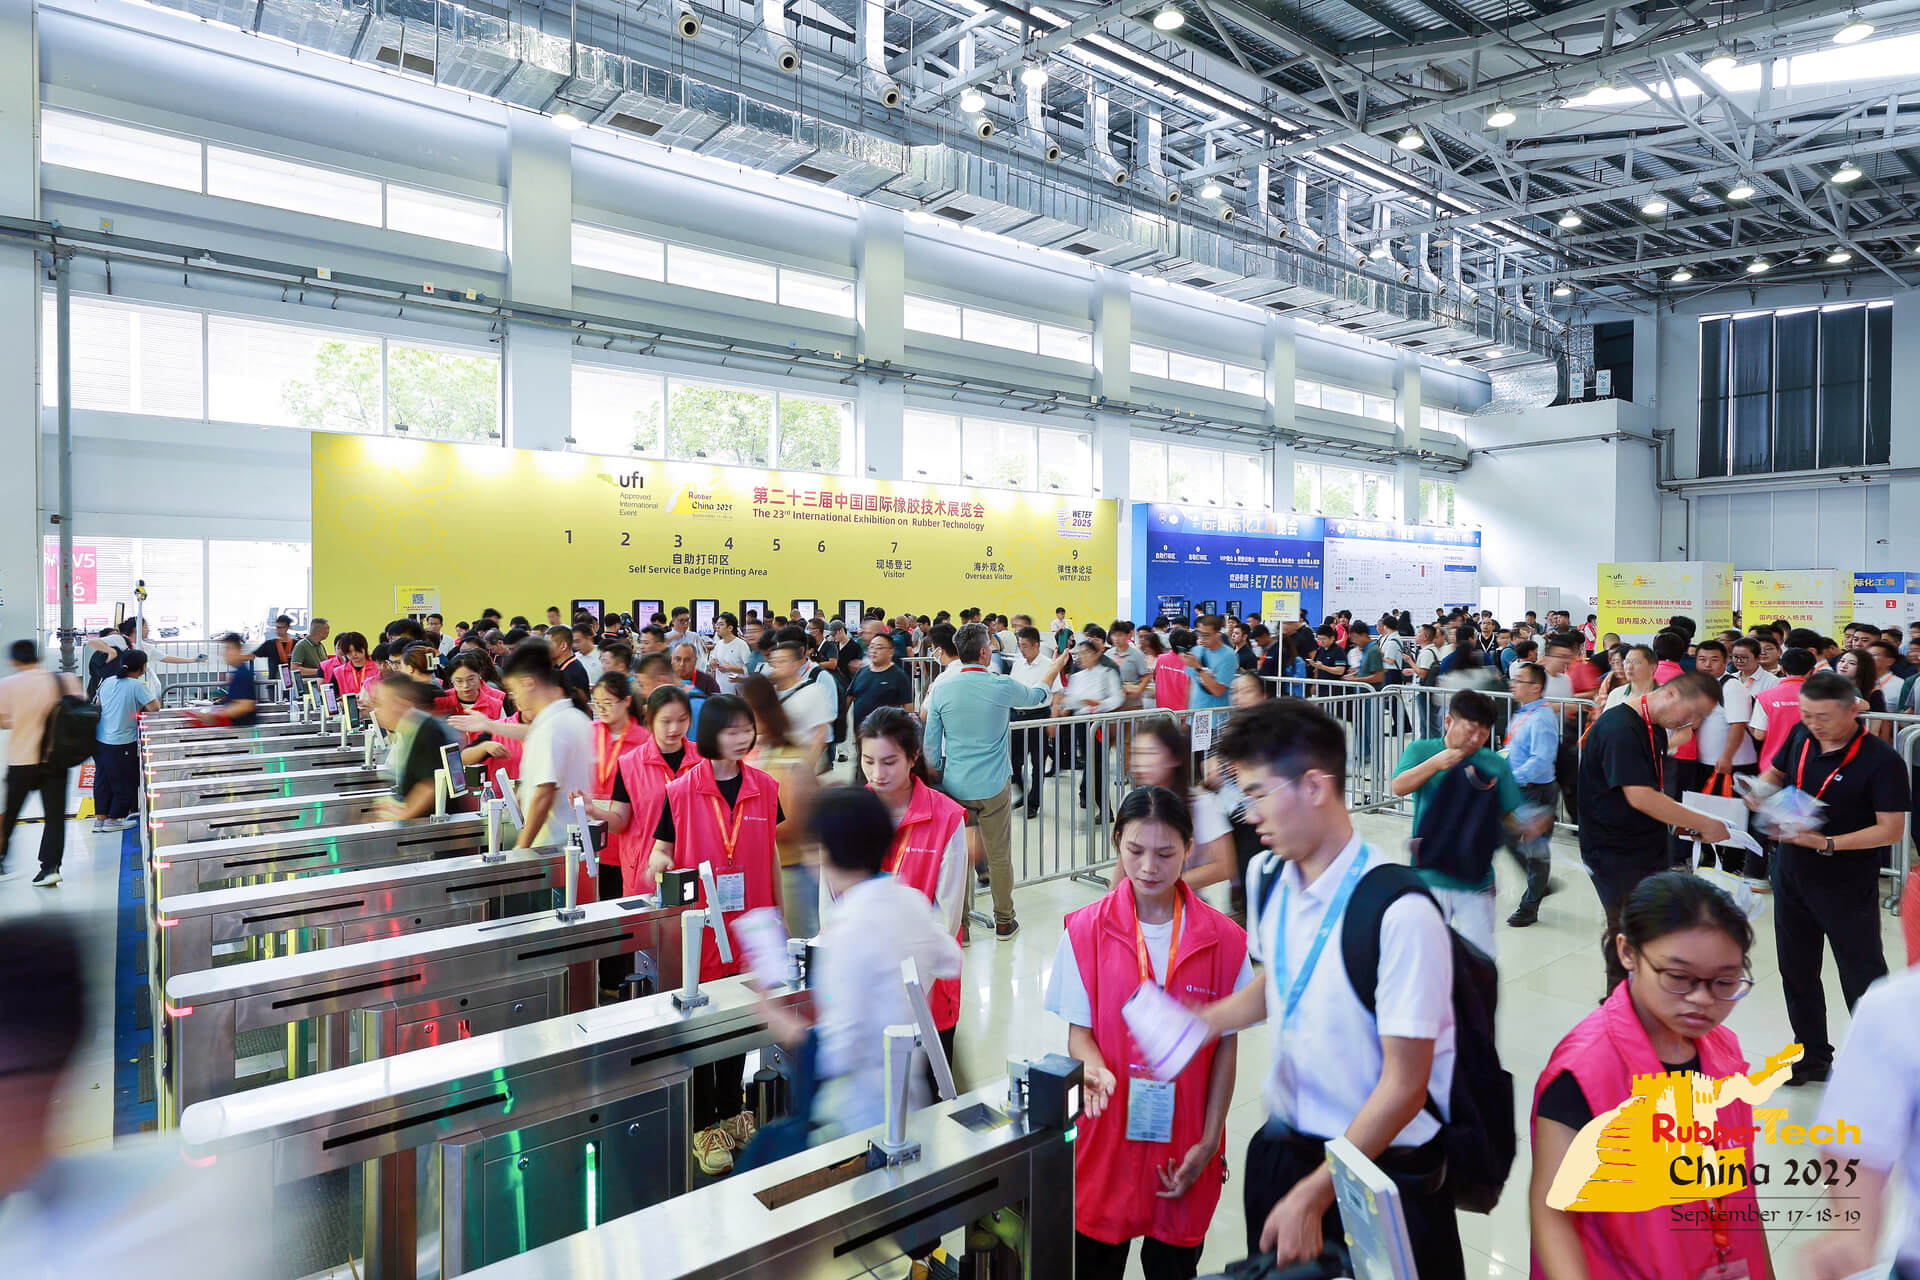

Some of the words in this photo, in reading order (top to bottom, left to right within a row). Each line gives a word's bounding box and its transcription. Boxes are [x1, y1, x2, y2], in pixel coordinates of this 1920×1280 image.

[619, 471, 644, 489] ufi
[620, 491, 651, 501] Approved
[619, 500, 659, 509] International
[691, 501, 715, 511] China
[716, 503, 733, 512] 2025
[752, 486, 986, 520] 第二十三届中国国际橡胶技术展览会
[619, 509, 638, 517] Event
[1072, 510, 1093, 519] WETEF
[753, 508, 771, 519] The
[773, 509, 791, 519] 23rd
[792, 510, 852, 523] International
[853, 514, 896, 526] Exhibition
[898, 518, 909, 526] on
[912, 517, 941, 529] Rubber
[942, 519, 985, 532] Technology
[1072, 518, 1092, 528] 2025
[564, 530, 573, 544] 1
[620, 532, 631, 546] 2
[674, 534, 683, 548] 3
[724, 537, 734, 550] 4
[772, 538, 781, 551] 5
[817, 540, 826, 553] 6
[890, 541, 898, 553] 7
[986, 546, 993, 557] 8
[1072, 549, 1078, 560] 9
[672, 553, 730, 565] 自助打印区
[876, 559, 912, 570] 现场登记
[973, 562, 1005, 572] 海外观众
[628, 565, 646, 574] Self
[648, 566, 681, 574] Service
[683, 566, 712, 577] Badge
[713, 567, 747, 577] Printing
[748, 568, 768, 576] Area
[965, 573, 993, 581] Overseas
[994, 573, 1013, 581] Visitor
[1059, 574, 1077, 582] WETEF
[1255, 574, 1268, 589] E7
[1270, 575, 1283, 589] E6
[1285, 575, 1299, 589] N5
[1301, 576, 1314, 590] N4
[1616, 617, 1671, 625] 国内观众入场流
